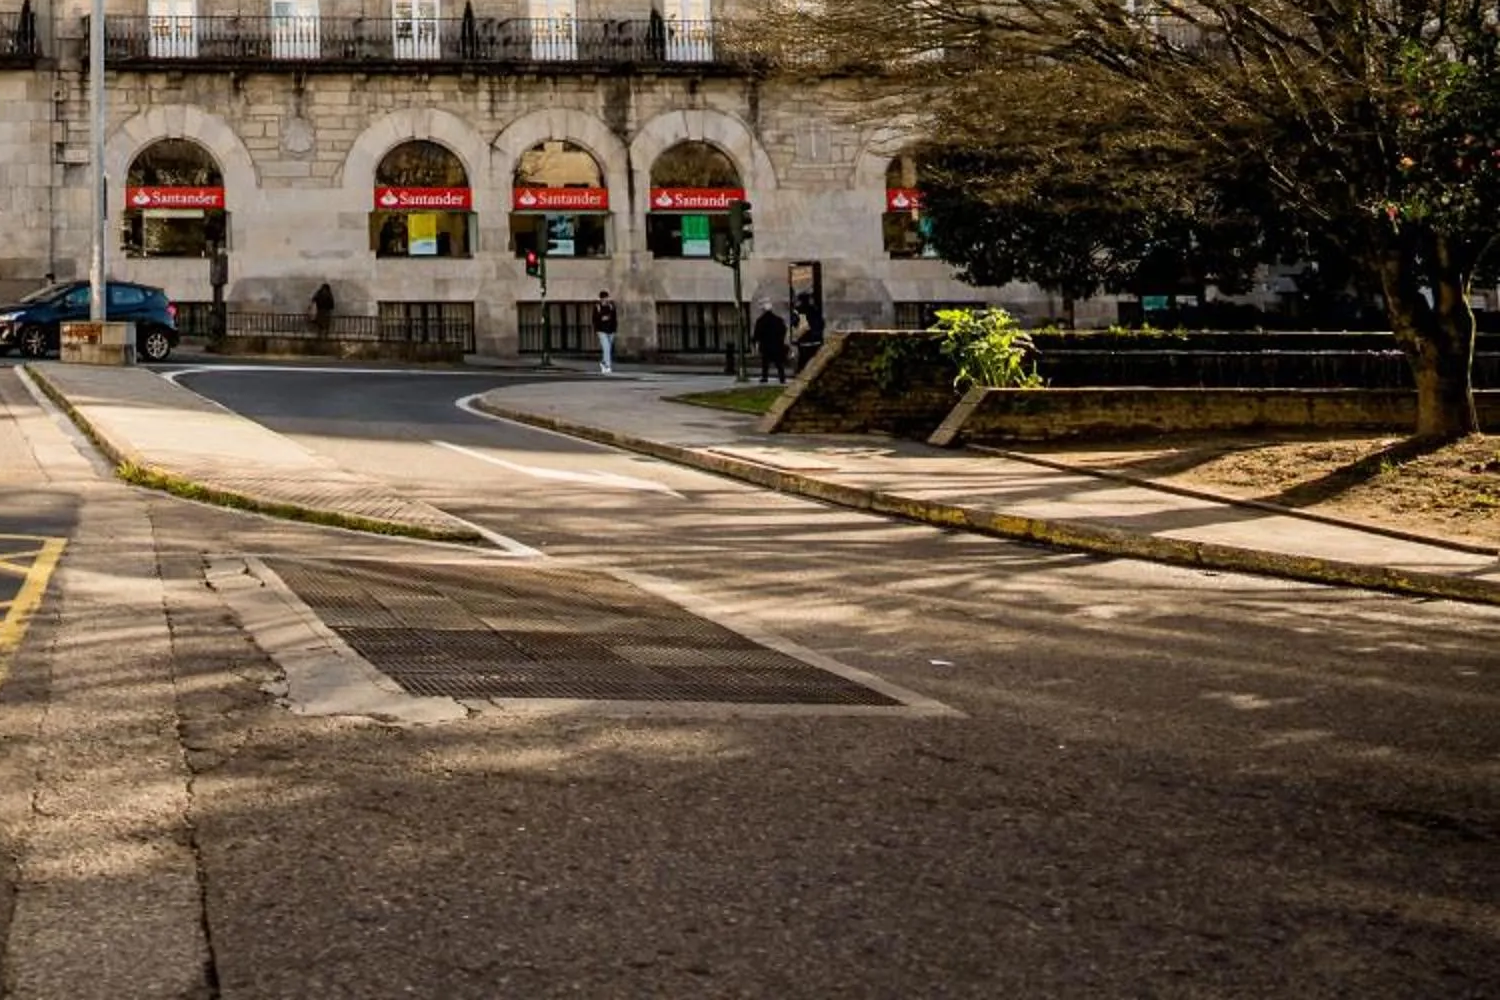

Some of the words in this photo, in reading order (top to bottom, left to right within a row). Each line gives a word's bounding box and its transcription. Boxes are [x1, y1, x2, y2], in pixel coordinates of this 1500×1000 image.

[150, 189, 218, 205] Santander
[399, 190, 464, 205] Santander
[537, 190, 602, 205] Santander
[674, 192, 739, 207] Santand
